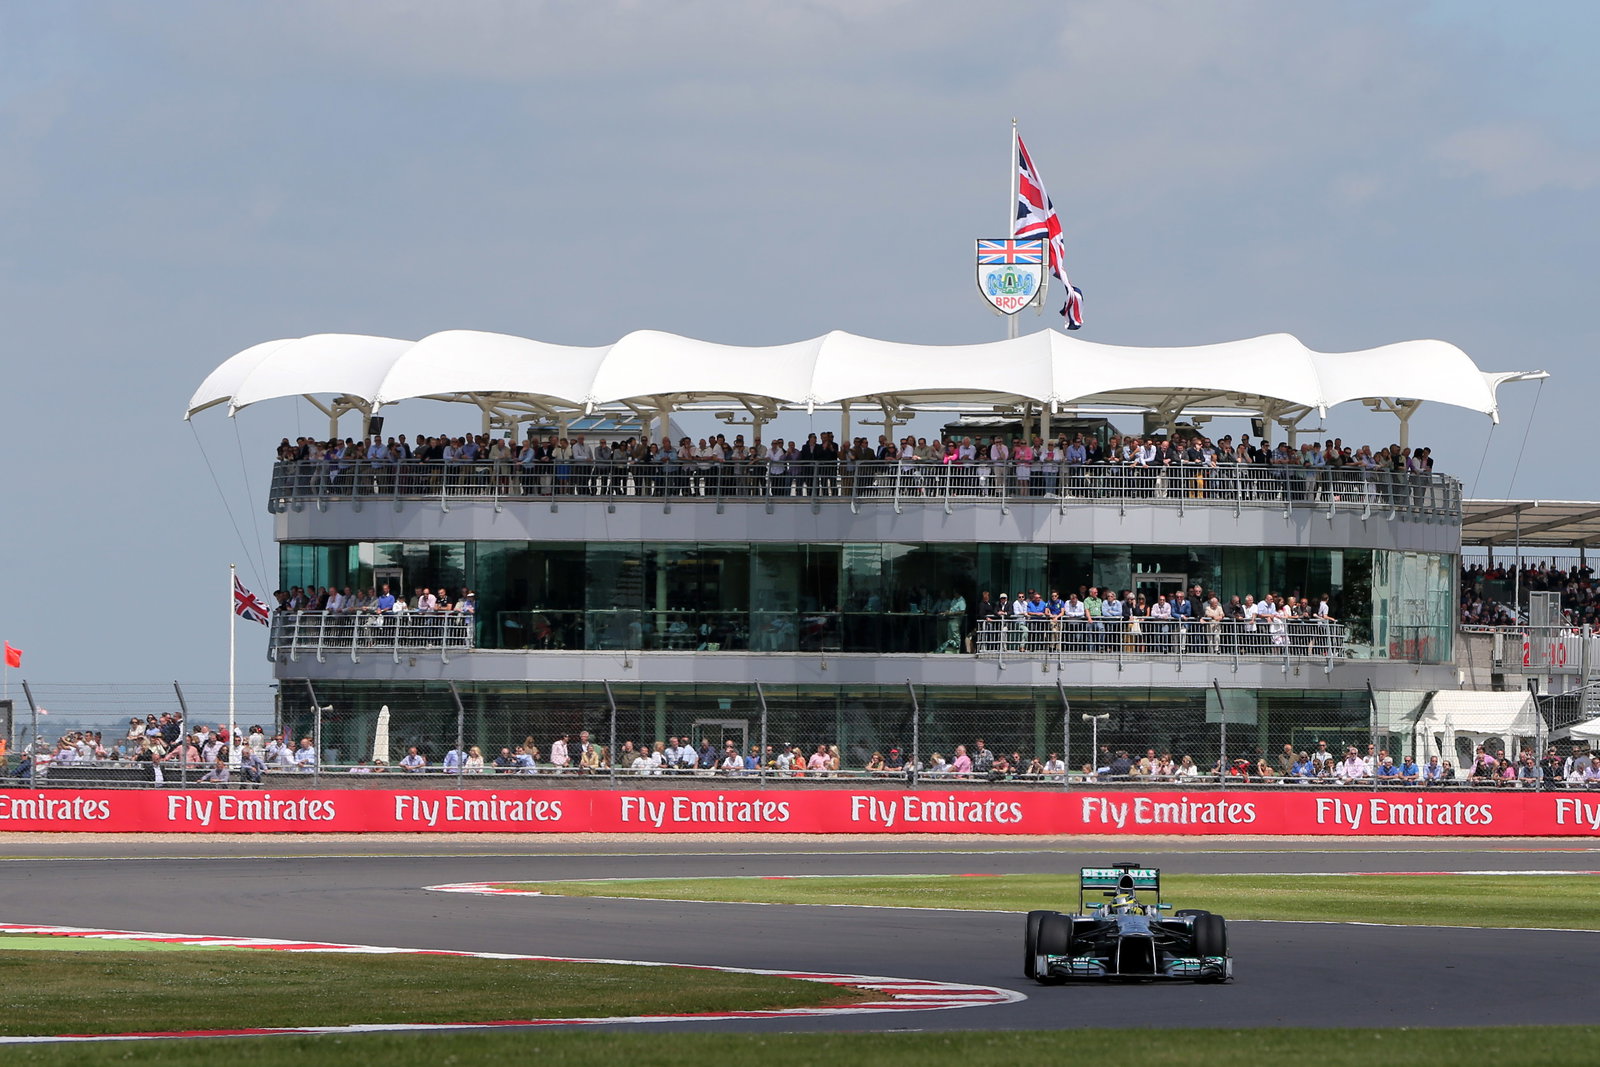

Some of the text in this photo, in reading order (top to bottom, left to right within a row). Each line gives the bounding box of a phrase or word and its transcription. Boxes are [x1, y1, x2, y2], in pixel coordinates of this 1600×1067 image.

[995, 296, 1024, 309] BRDC
[167, 794, 336, 826] Fly Emirates
[394, 794, 563, 827] Fly Emirates
[620, 795, 790, 828] Fly Emirates
[851, 795, 1023, 828] Fly Emirates
[1081, 796, 1256, 829] Fly Emirates
[1315, 797, 1493, 830] Fly Emirates
[1555, 798, 1600, 830] Fly
